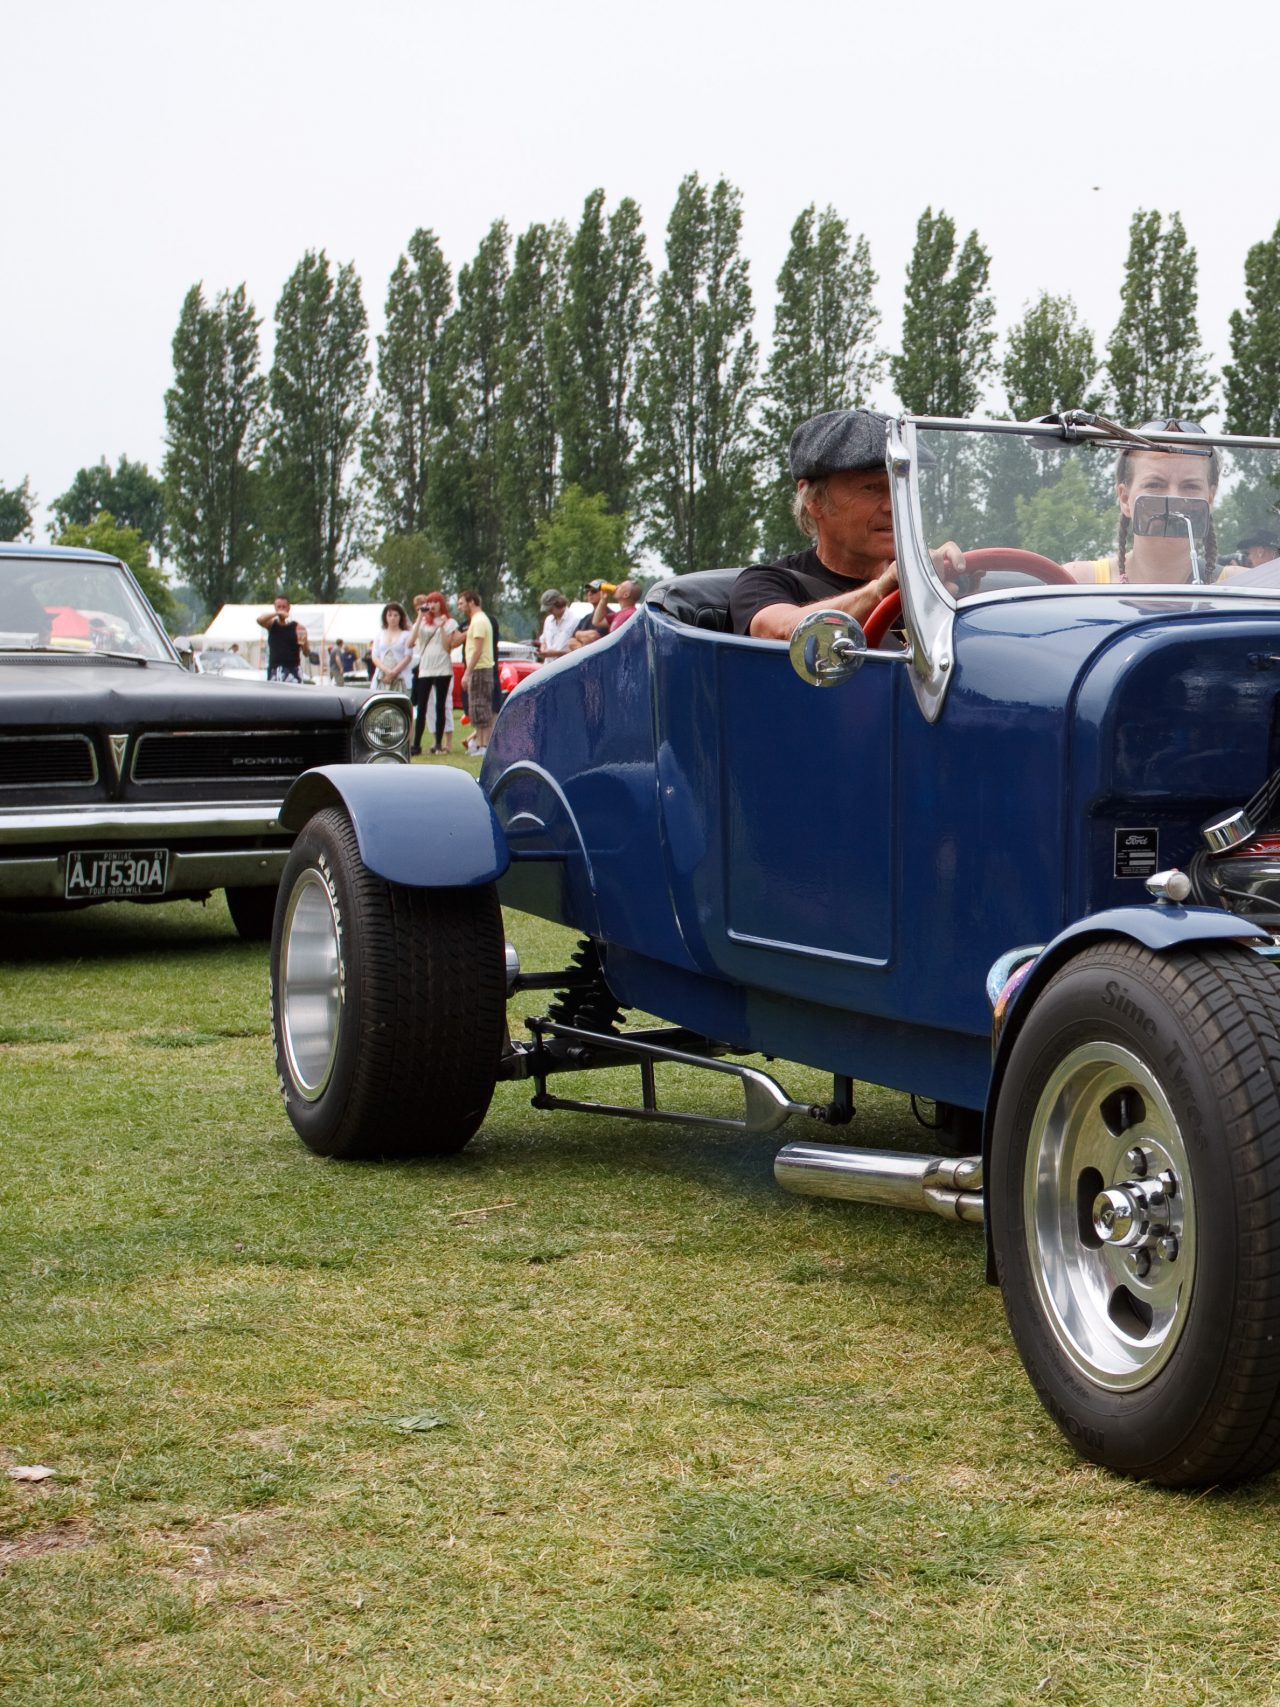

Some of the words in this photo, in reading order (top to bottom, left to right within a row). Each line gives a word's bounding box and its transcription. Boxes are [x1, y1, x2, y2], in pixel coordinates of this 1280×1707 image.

[232, 756, 305, 765] PONTIAC
[1125, 835, 1148, 845] Ford
[69, 860, 163, 888] AJT530A
[1101, 980, 1158, 1038] Sime
